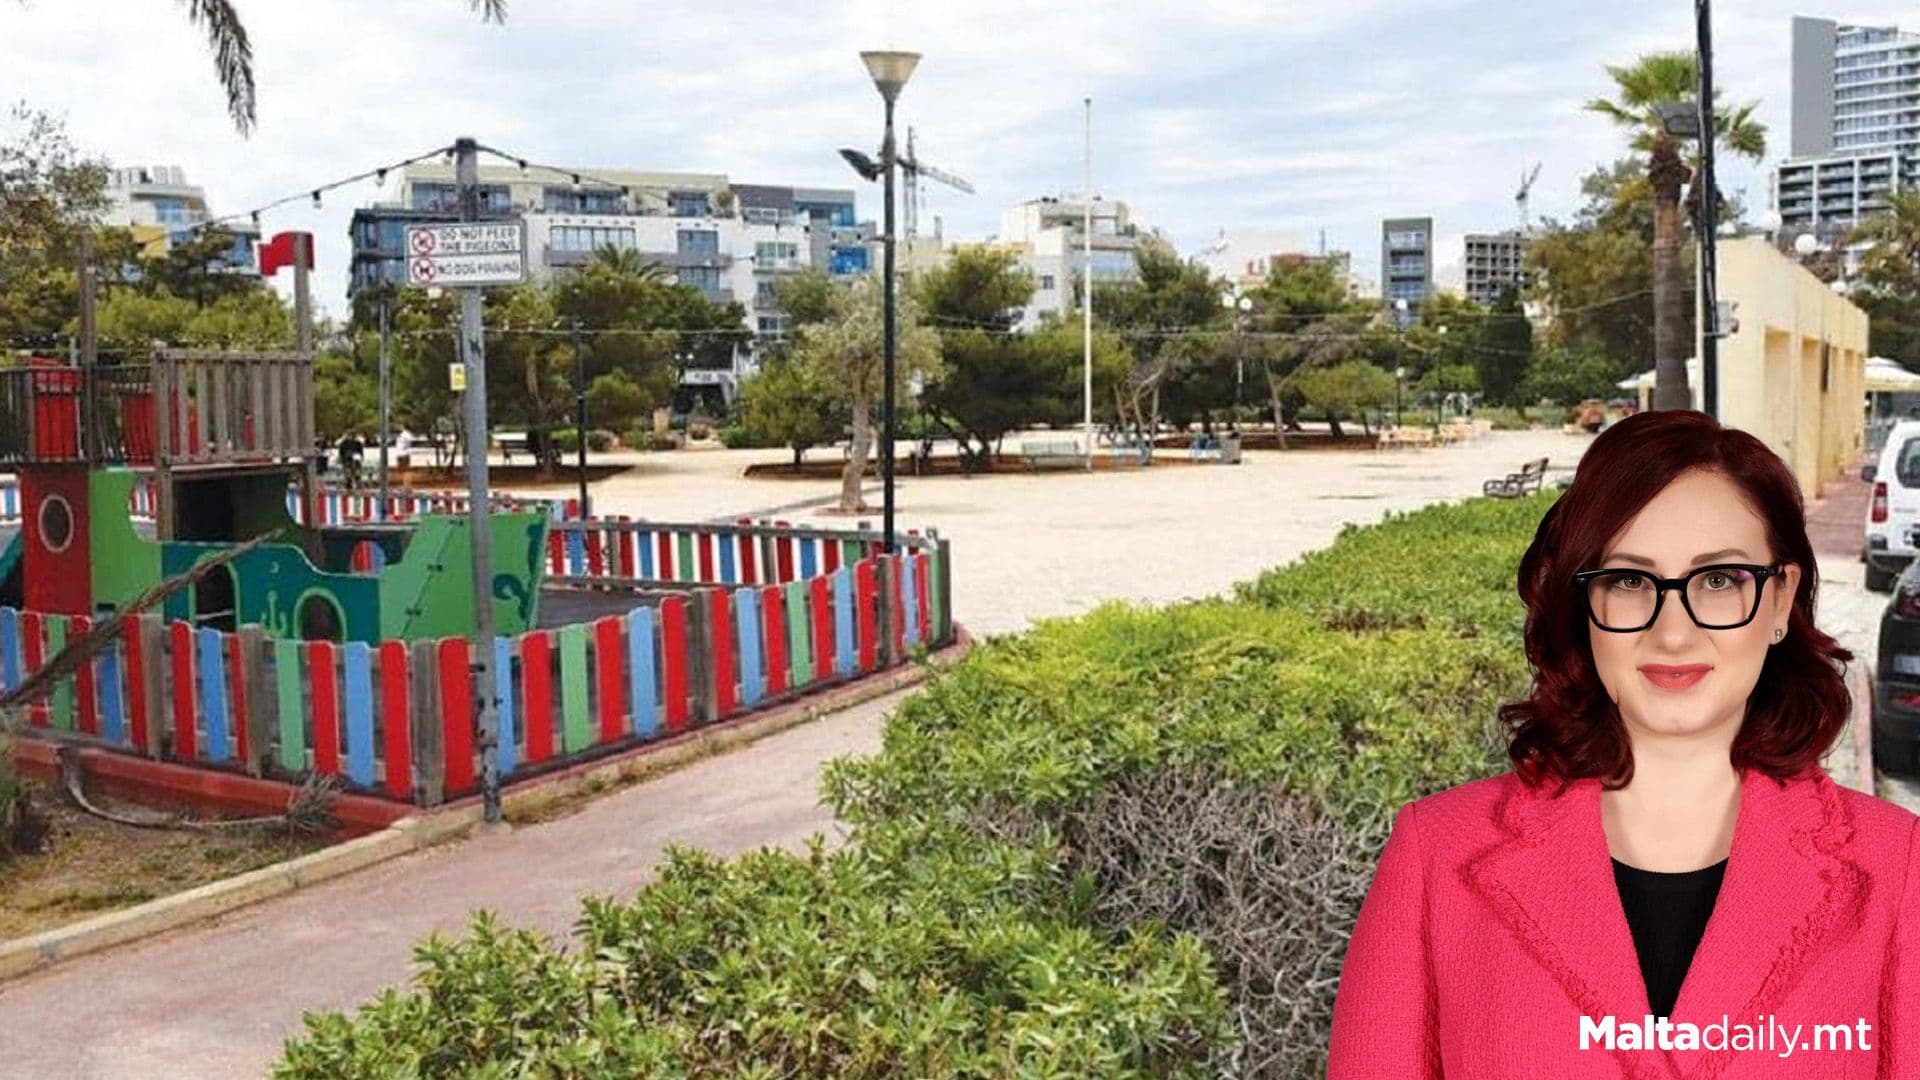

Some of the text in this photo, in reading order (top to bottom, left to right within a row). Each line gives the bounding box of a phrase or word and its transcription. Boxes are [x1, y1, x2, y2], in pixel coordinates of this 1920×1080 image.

[440, 228, 457, 241] DO
[460, 228, 482, 240] NOT
[438, 263, 453, 275] NO
[455, 262, 477, 275] DOG
